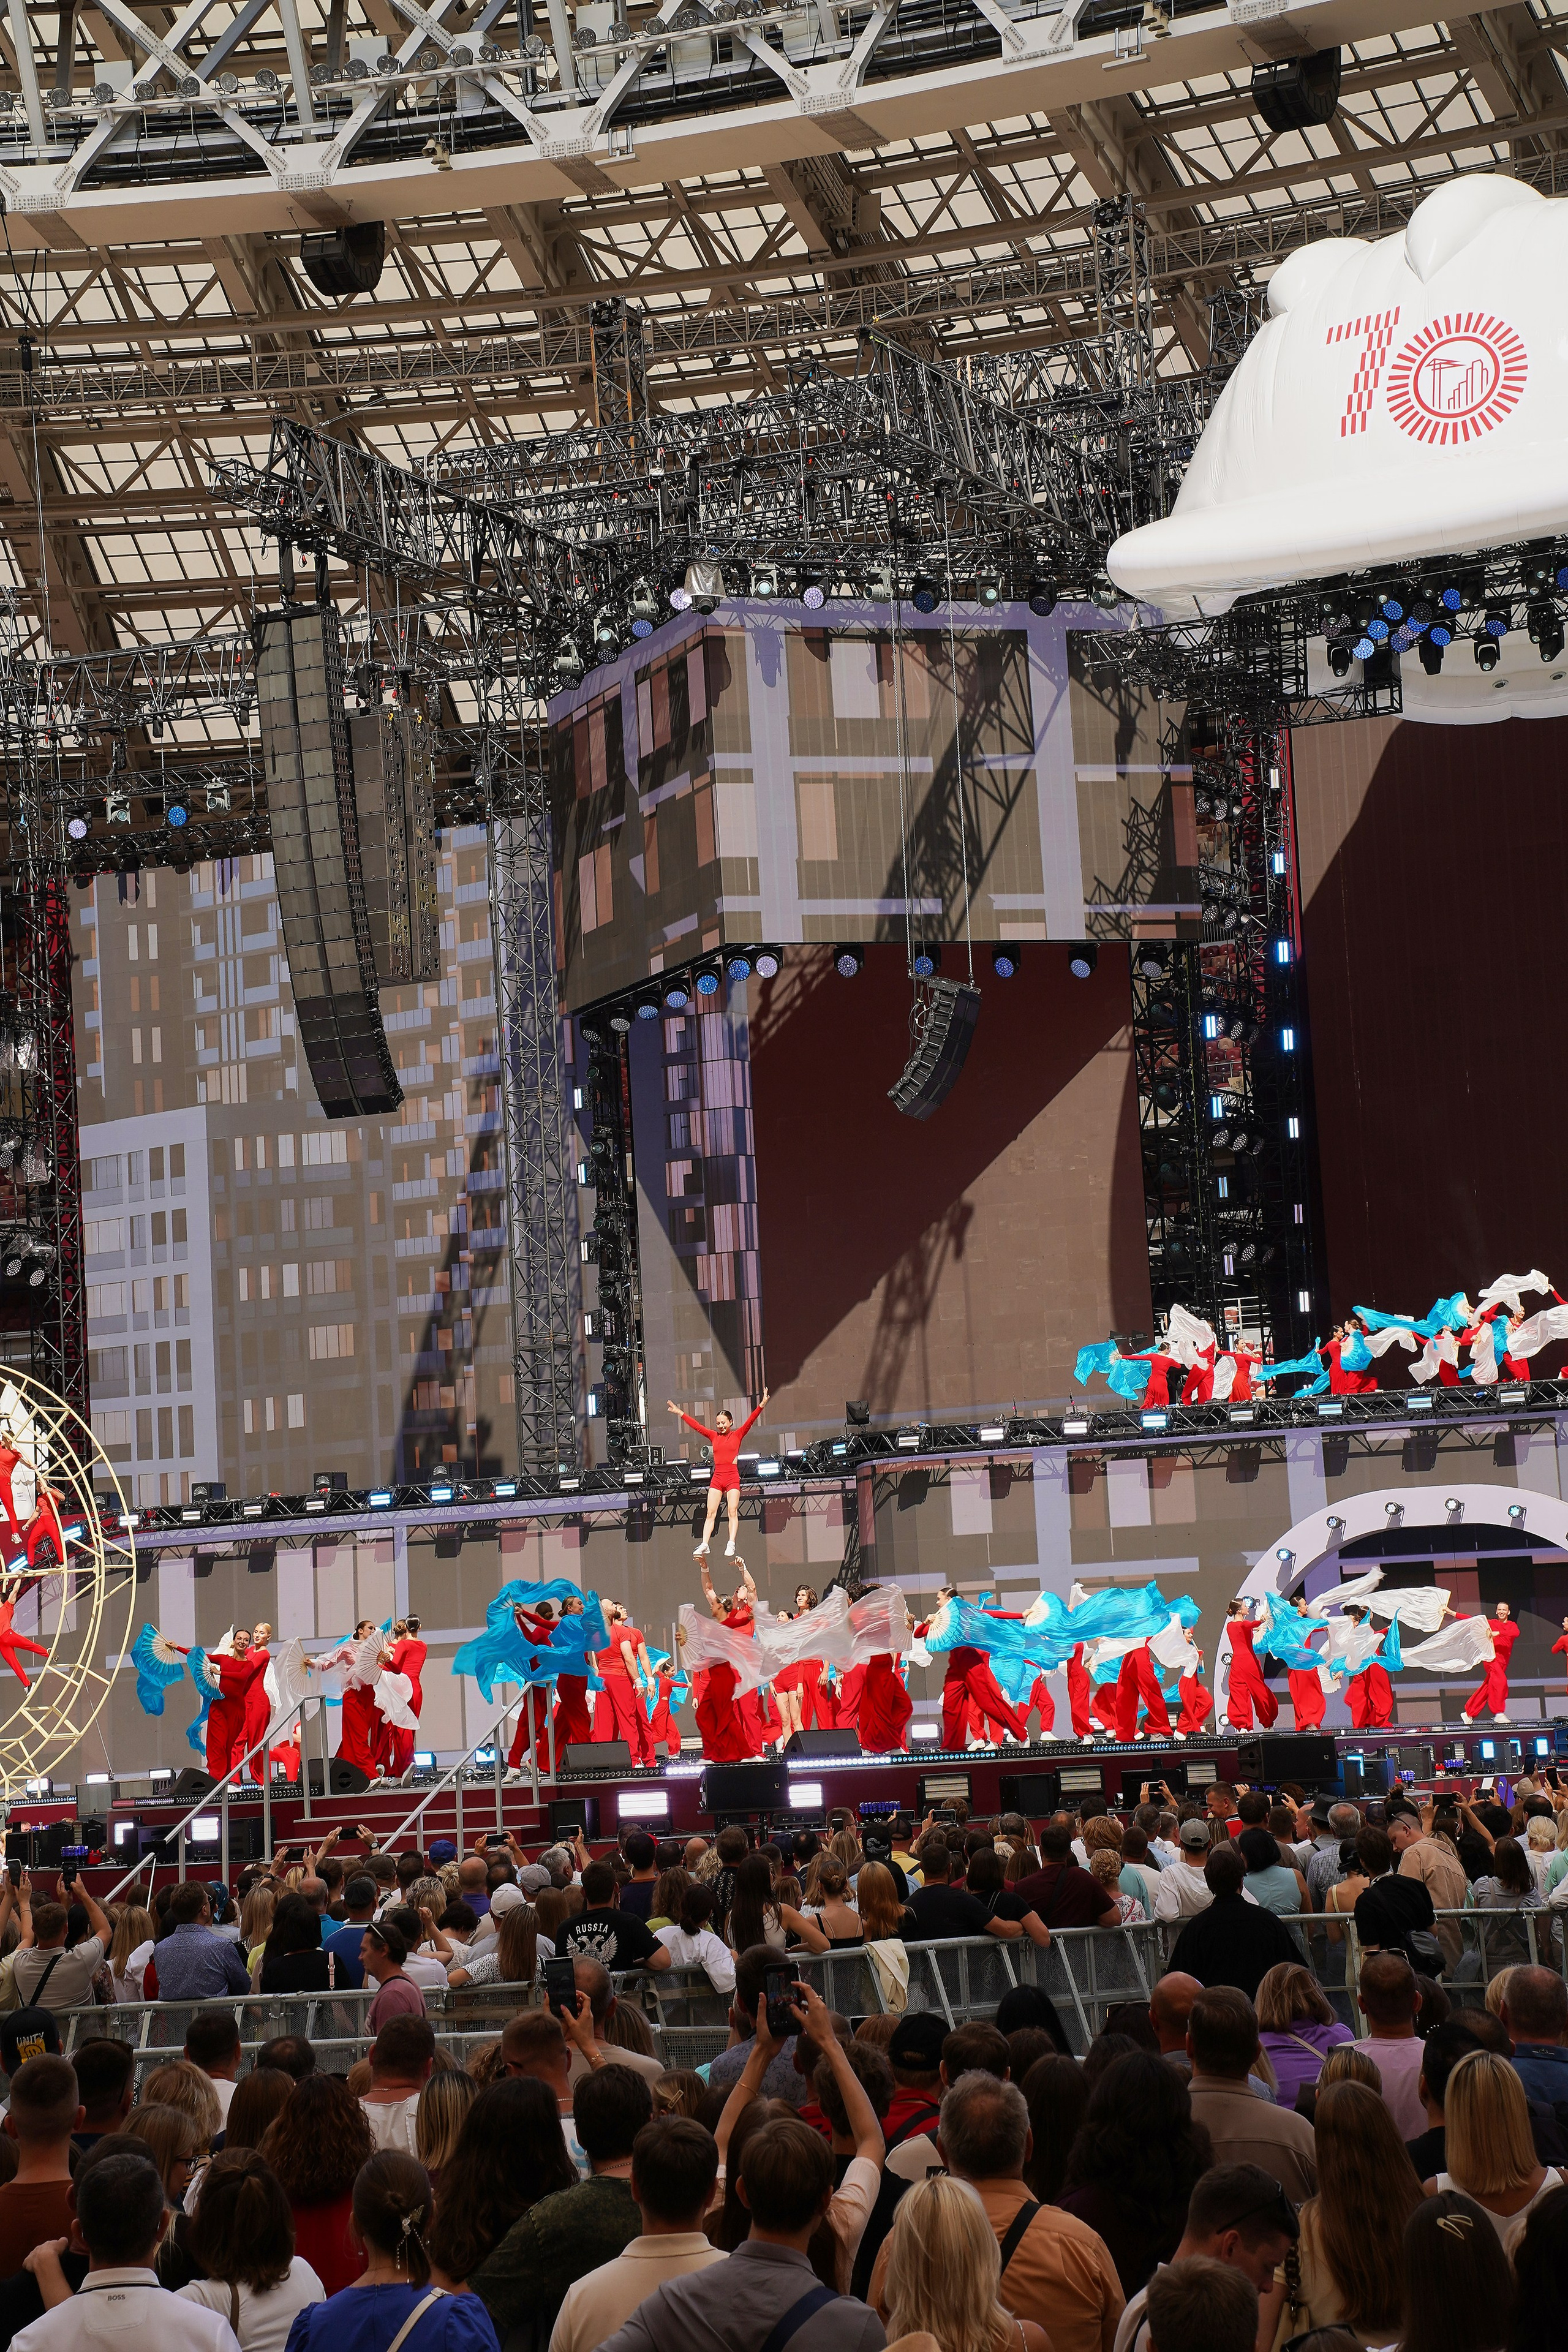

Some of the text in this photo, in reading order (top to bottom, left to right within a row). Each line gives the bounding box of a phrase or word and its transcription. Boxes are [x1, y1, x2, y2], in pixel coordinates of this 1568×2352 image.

[1325, 305, 1528, 445] 70
[575, 1923, 609, 1935] RUSSIA
[16, 2031, 44, 2048] UNITY
